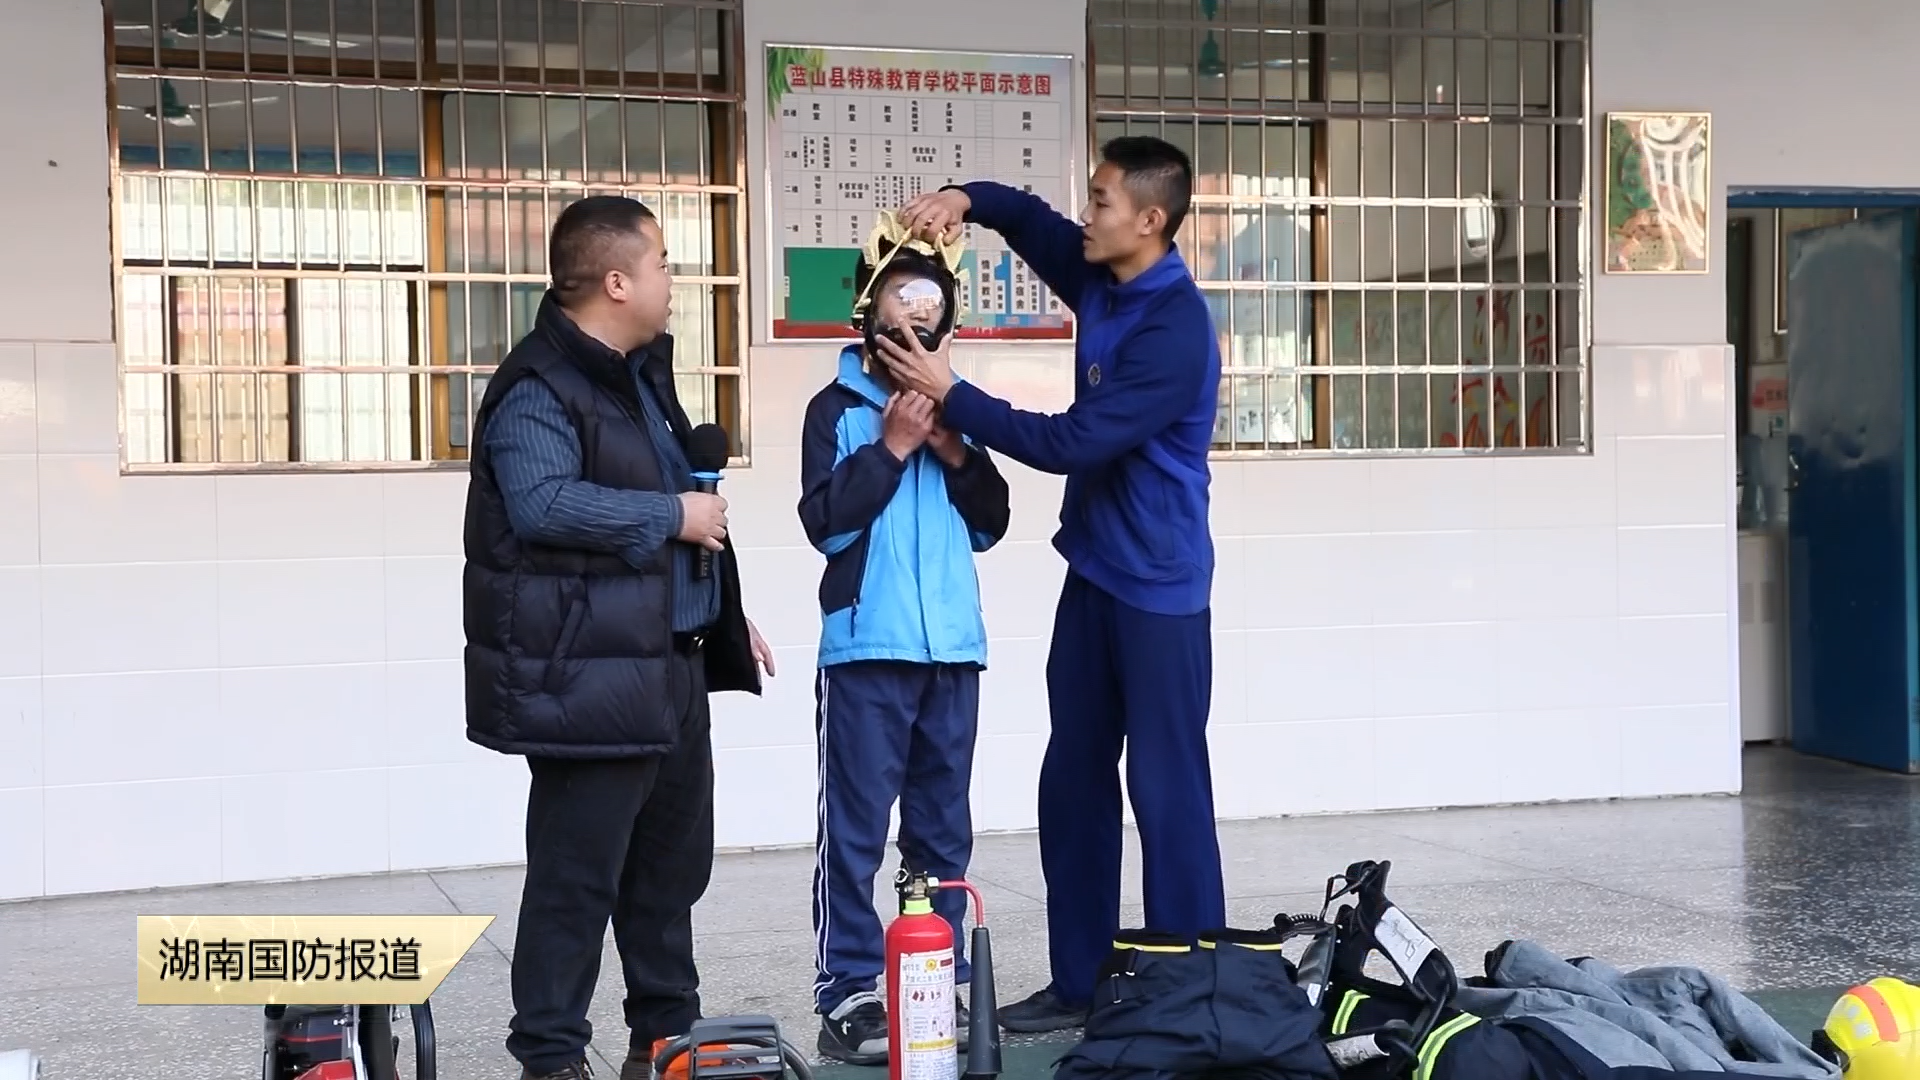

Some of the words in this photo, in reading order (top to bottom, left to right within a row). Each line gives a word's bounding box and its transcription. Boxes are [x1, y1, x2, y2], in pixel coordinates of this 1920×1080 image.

[789, 65, 1052, 96] 蓝山县特殊教育学校平面示意图
[812, 103, 820, 121] 教室
[848, 104, 856, 122] 教室
[884, 105, 892, 123] 教室
[1022, 111, 1031, 131] 厕所
[1022, 148, 1032, 168] 厕所
[1015, 260, 1024, 309] 学生宿舍
